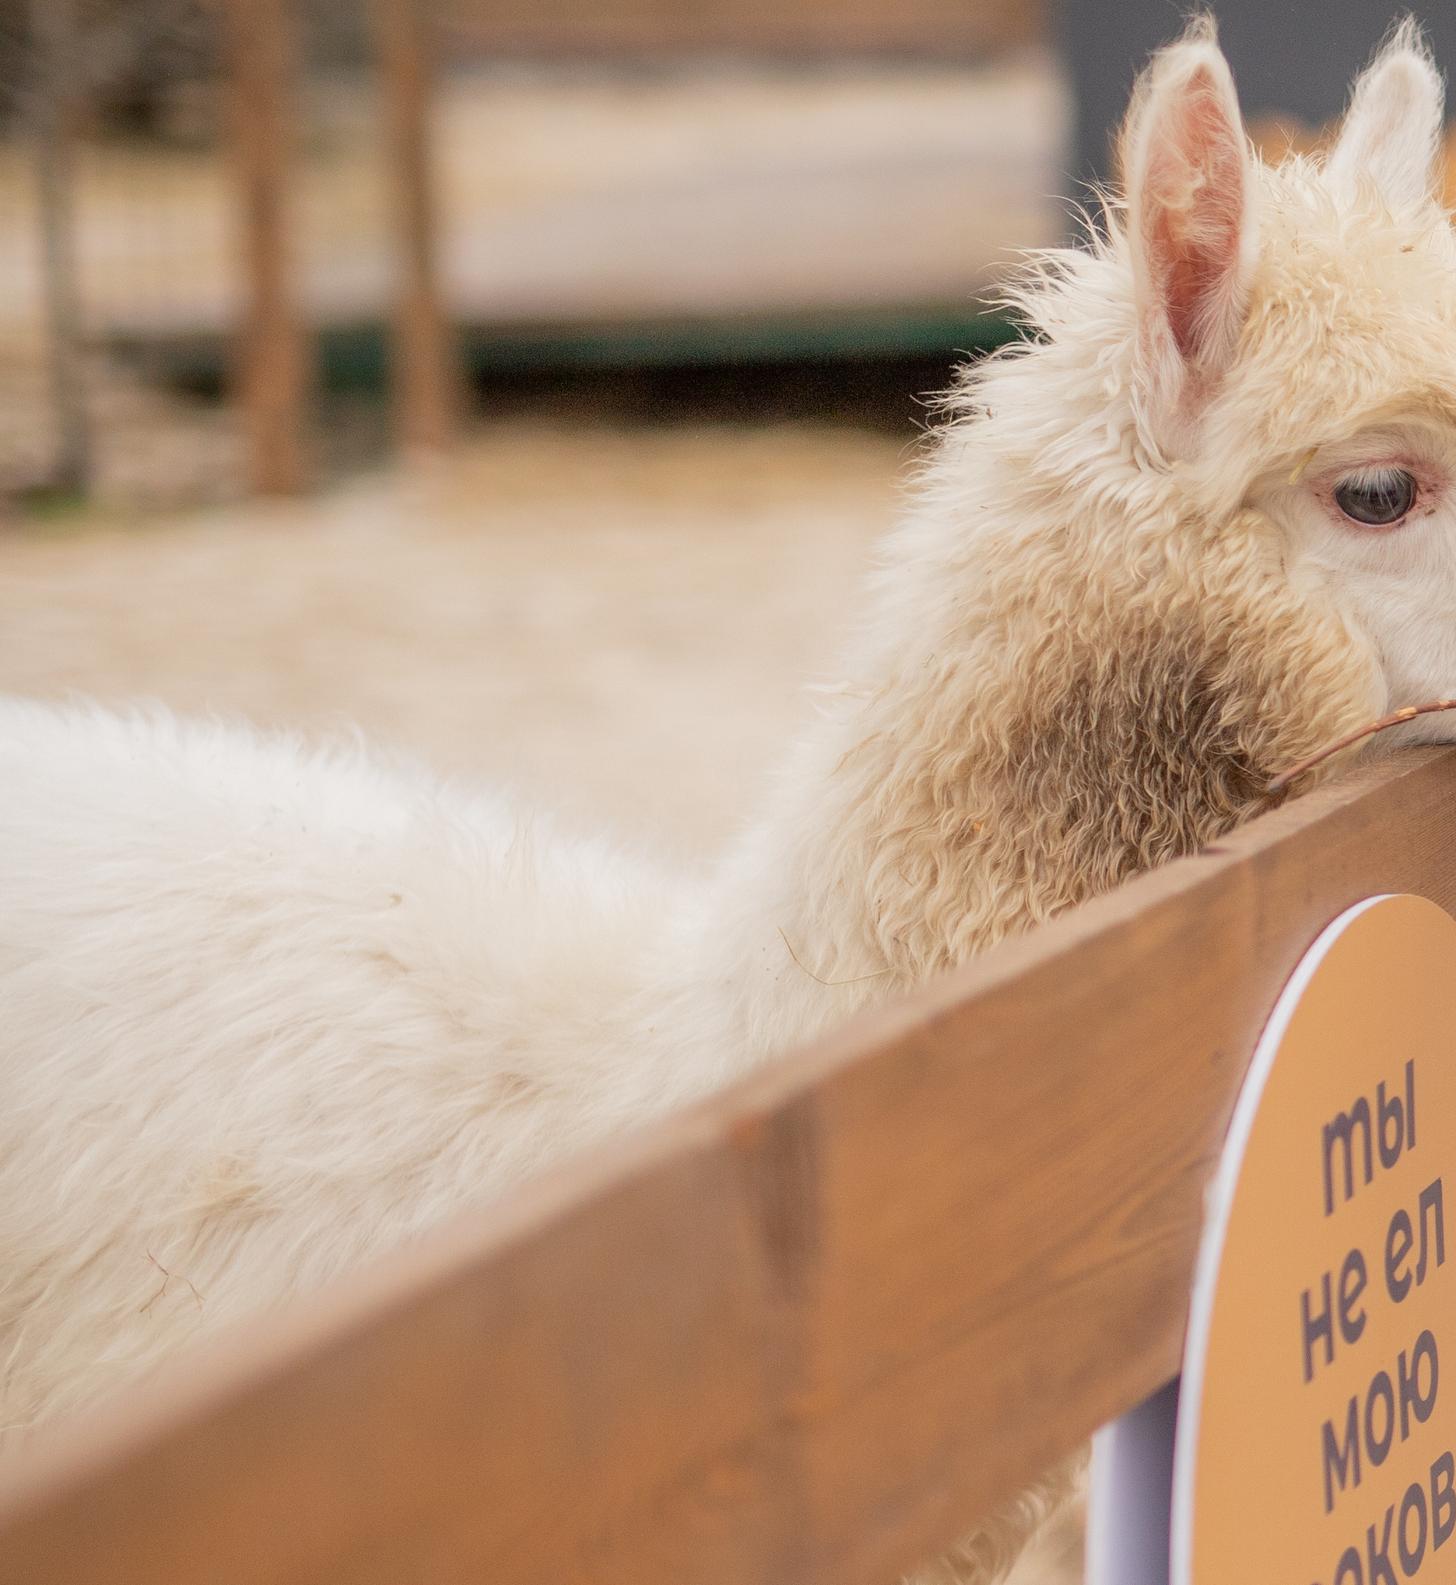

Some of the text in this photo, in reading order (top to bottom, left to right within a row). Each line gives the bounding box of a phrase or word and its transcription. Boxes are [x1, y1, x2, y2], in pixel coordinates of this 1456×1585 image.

[1322, 1058, 1415, 1217] ты
[1302, 1177, 1446, 1384] не ел
[1322, 1329, 1439, 1514] мою
